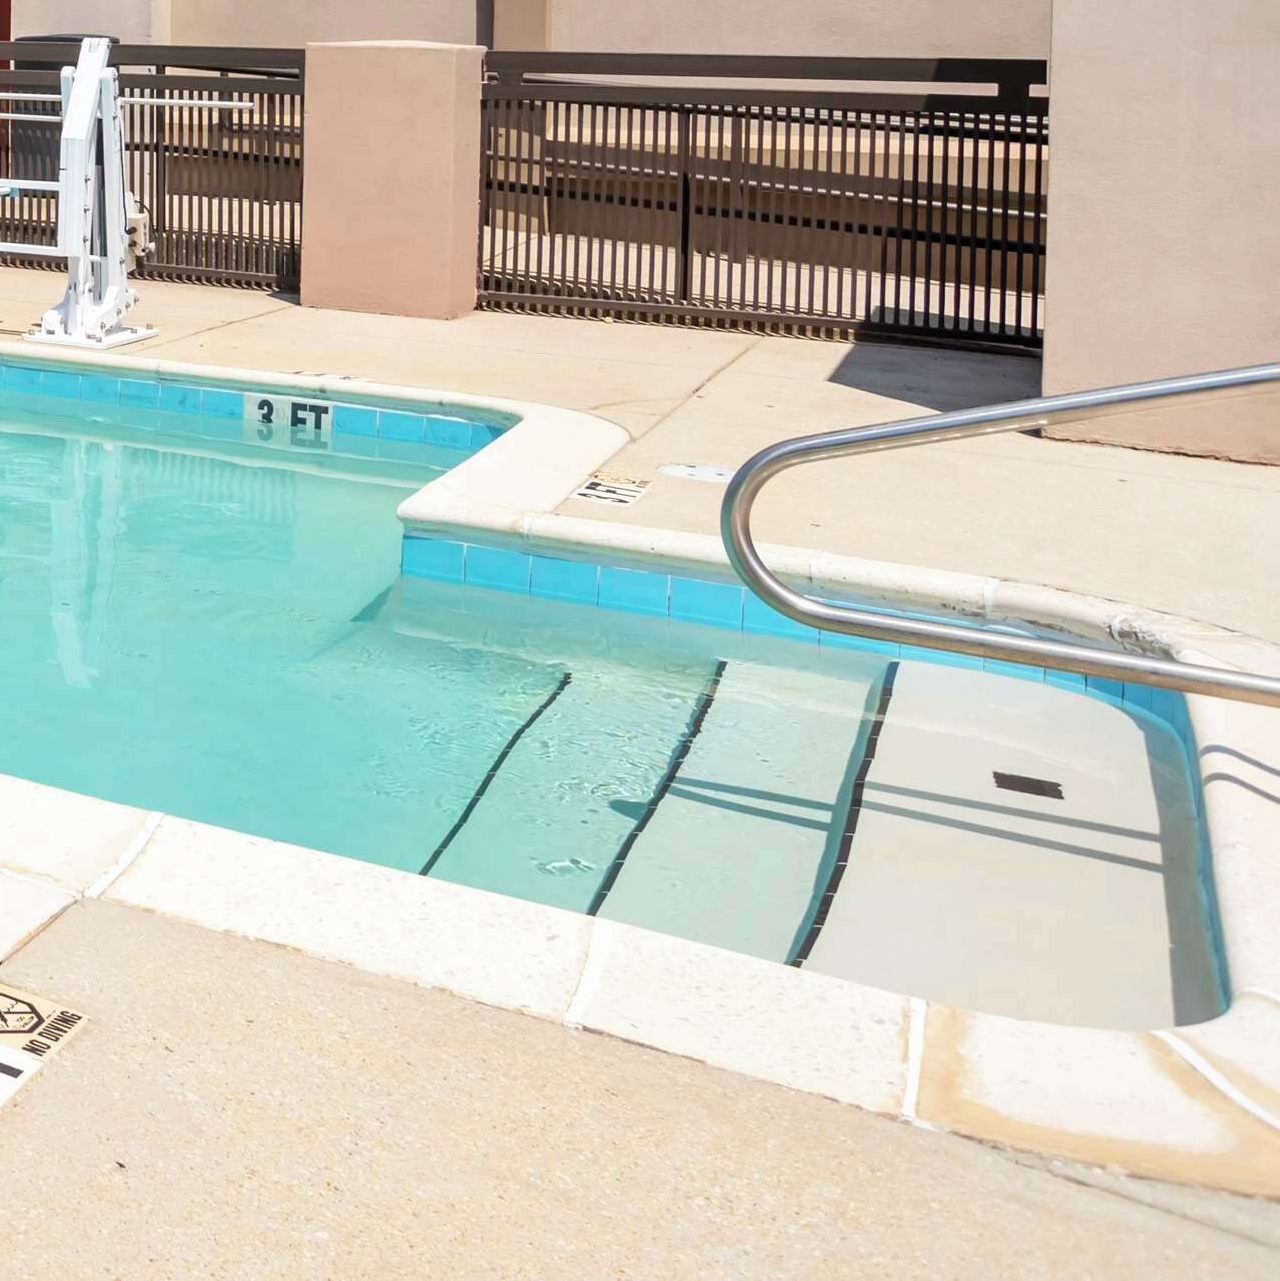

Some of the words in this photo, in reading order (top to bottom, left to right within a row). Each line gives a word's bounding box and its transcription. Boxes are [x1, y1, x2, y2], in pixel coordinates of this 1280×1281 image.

[257, 399, 274, 423] 3
[290, 402, 329, 430] FT
[22, 1039, 51, 1057] NO
[37, 1011, 83, 1042] DIVING
